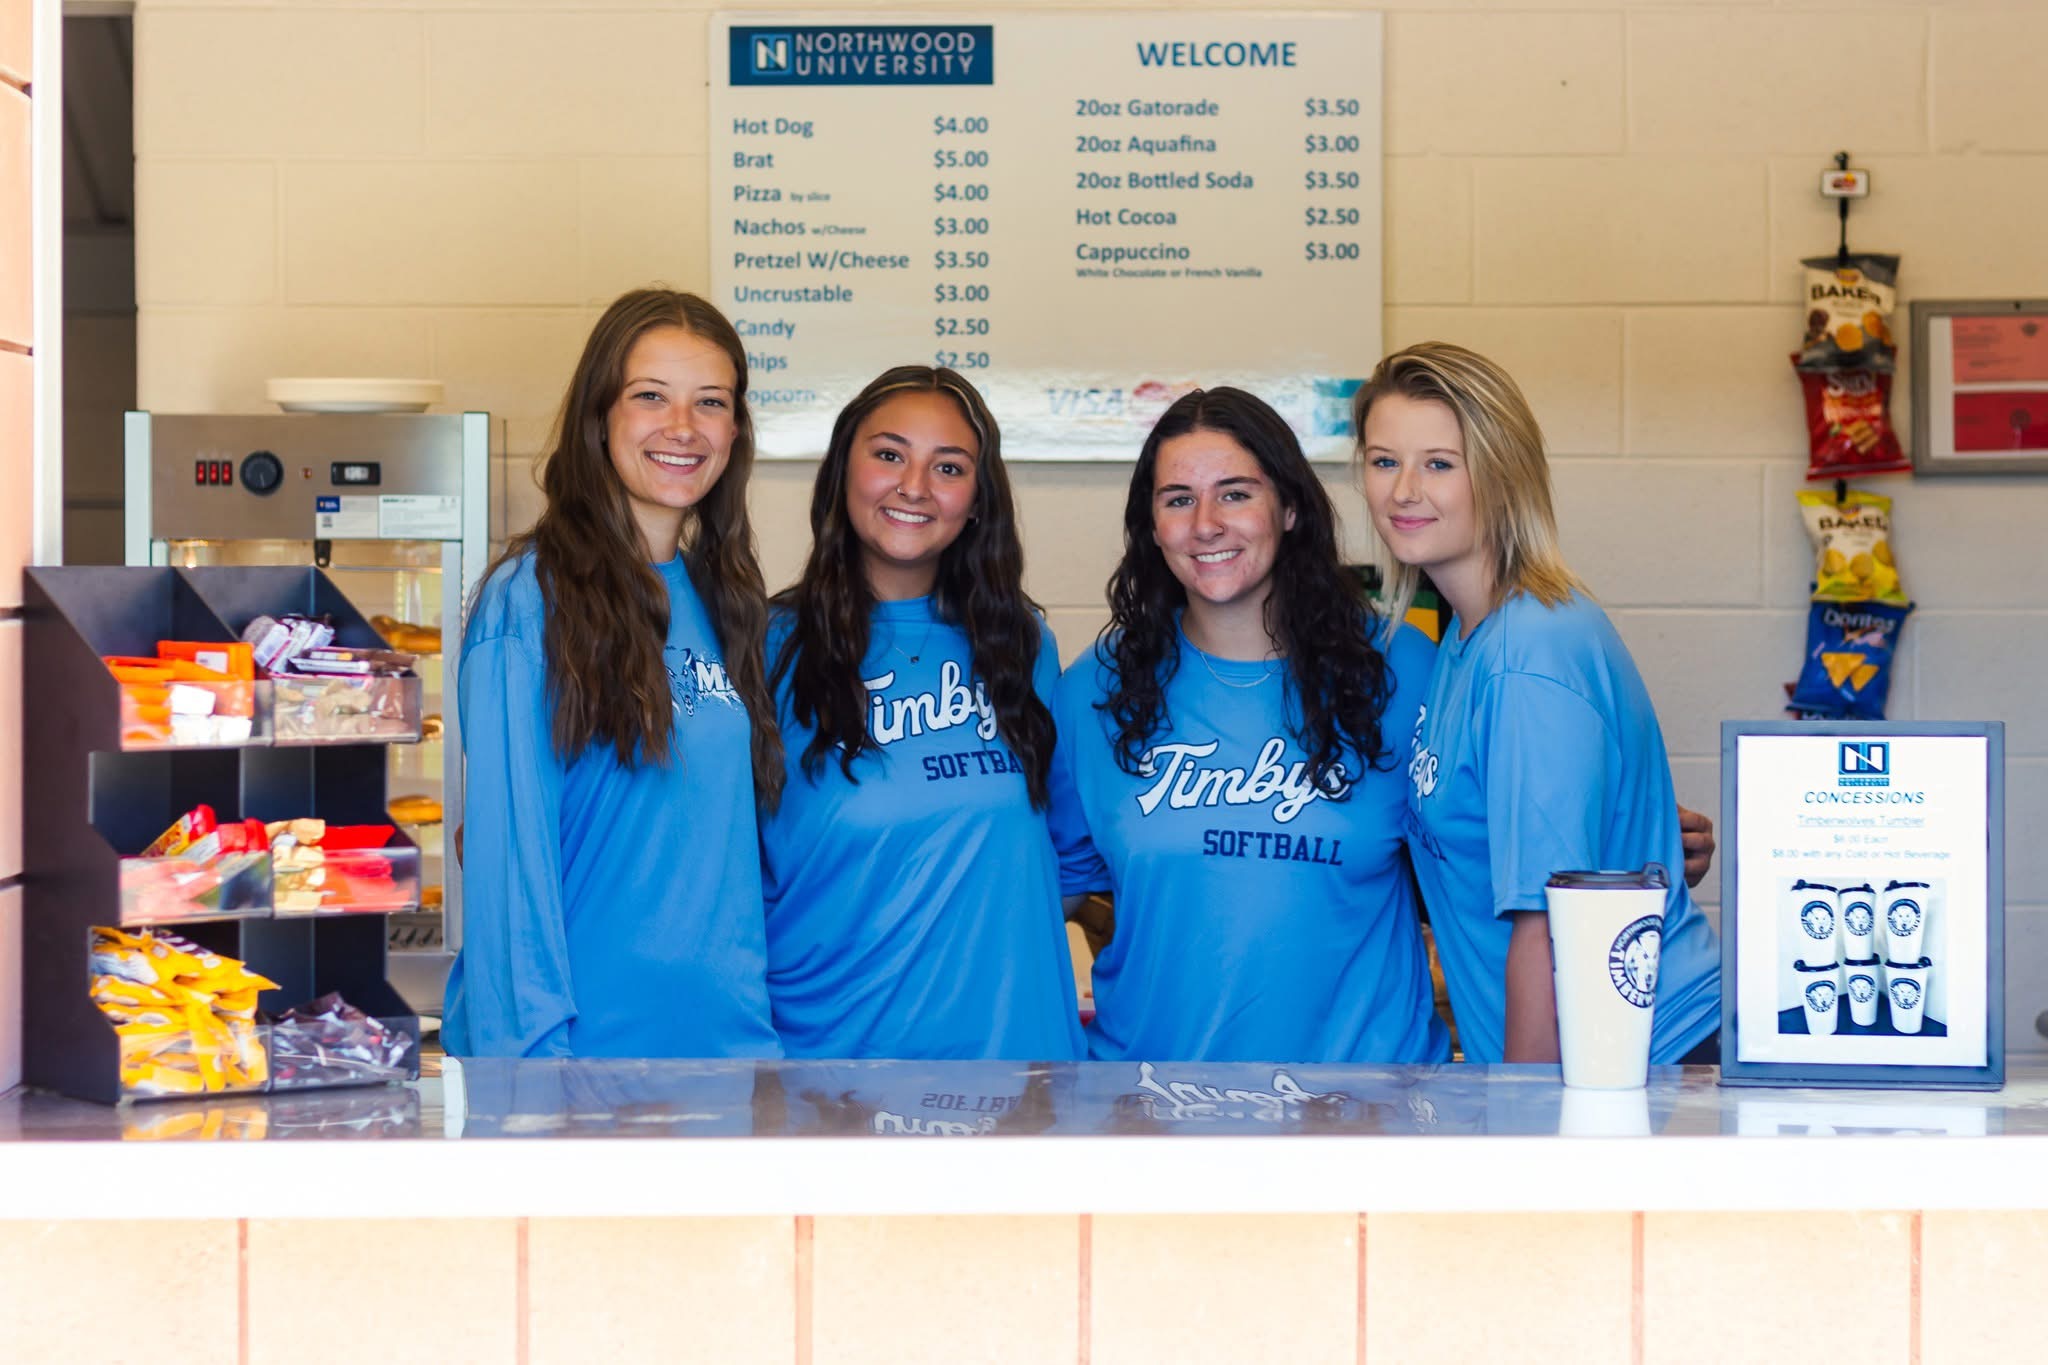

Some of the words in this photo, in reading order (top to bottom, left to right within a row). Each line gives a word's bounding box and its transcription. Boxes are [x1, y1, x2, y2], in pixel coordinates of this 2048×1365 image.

[796, 33, 975, 53] NORTHWOOD
[1137, 42, 1296, 67] WELCOME
[796, 55, 974, 75] UNIVERSITY
[1076, 99, 1121, 116] 20oz
[1127, 99, 1219, 116] Gatorade
[1305, 98, 1360, 117] $3.50
[733, 119, 768, 134] Hot
[775, 118, 814, 139] Dog
[934, 116, 989, 135] $4.00
[1076, 136, 1121, 152] 20oz
[1128, 135, 1216, 155] Aquafina
[1305, 134, 1359, 153] $3.00
[733, 152, 773, 168] Brat
[934, 149, 989, 168] $5.00
[1076, 172, 1121, 189] 20oz
[1128, 172, 1199, 189] Bottled
[1206, 171, 1254, 189] Soda
[1305, 171, 1359, 190] $3.50
[734, 185, 781, 202] Pizza
[790, 192, 804, 203] by
[807, 192, 831, 202] slice
[935, 183, 989, 202] $4.00
[734, 219, 806, 235] Nachos
[811, 225, 866, 235] w/Cheese
[934, 217, 989, 236] $3.00
[1077, 209, 1111, 225] Hot
[1118, 208, 1177, 225] Cocoa
[1305, 207, 1360, 226] $2.50
[734, 252, 801, 269] Pretzel
[807, 250, 910, 271] W/Cheese
[934, 250, 989, 270] $3.50
[1076, 243, 1190, 263] Cappuccino
[1305, 242, 1360, 261] $3.00
[1076, 268, 1109, 277] White
[1112, 268, 1167, 278] Chocolate
[1170, 270, 1182, 278] or
[1185, 268, 1222, 277] French
[1225, 268, 1263, 278] Vanilla
[735, 285, 853, 302] Uncrustable
[935, 284, 989, 303] $3.00
[735, 320, 795, 340] Candy
[935, 317, 989, 336] $2.50
[749, 352, 787, 373] hips
[936, 351, 990, 370] $2.50
[749, 390, 816, 406] opcorn
[1804, 791, 1925, 804] CONCESSIONS
[1797, 815, 1875, 826] Timberwolves
[1203, 829, 1343, 866] SOFTBALL
